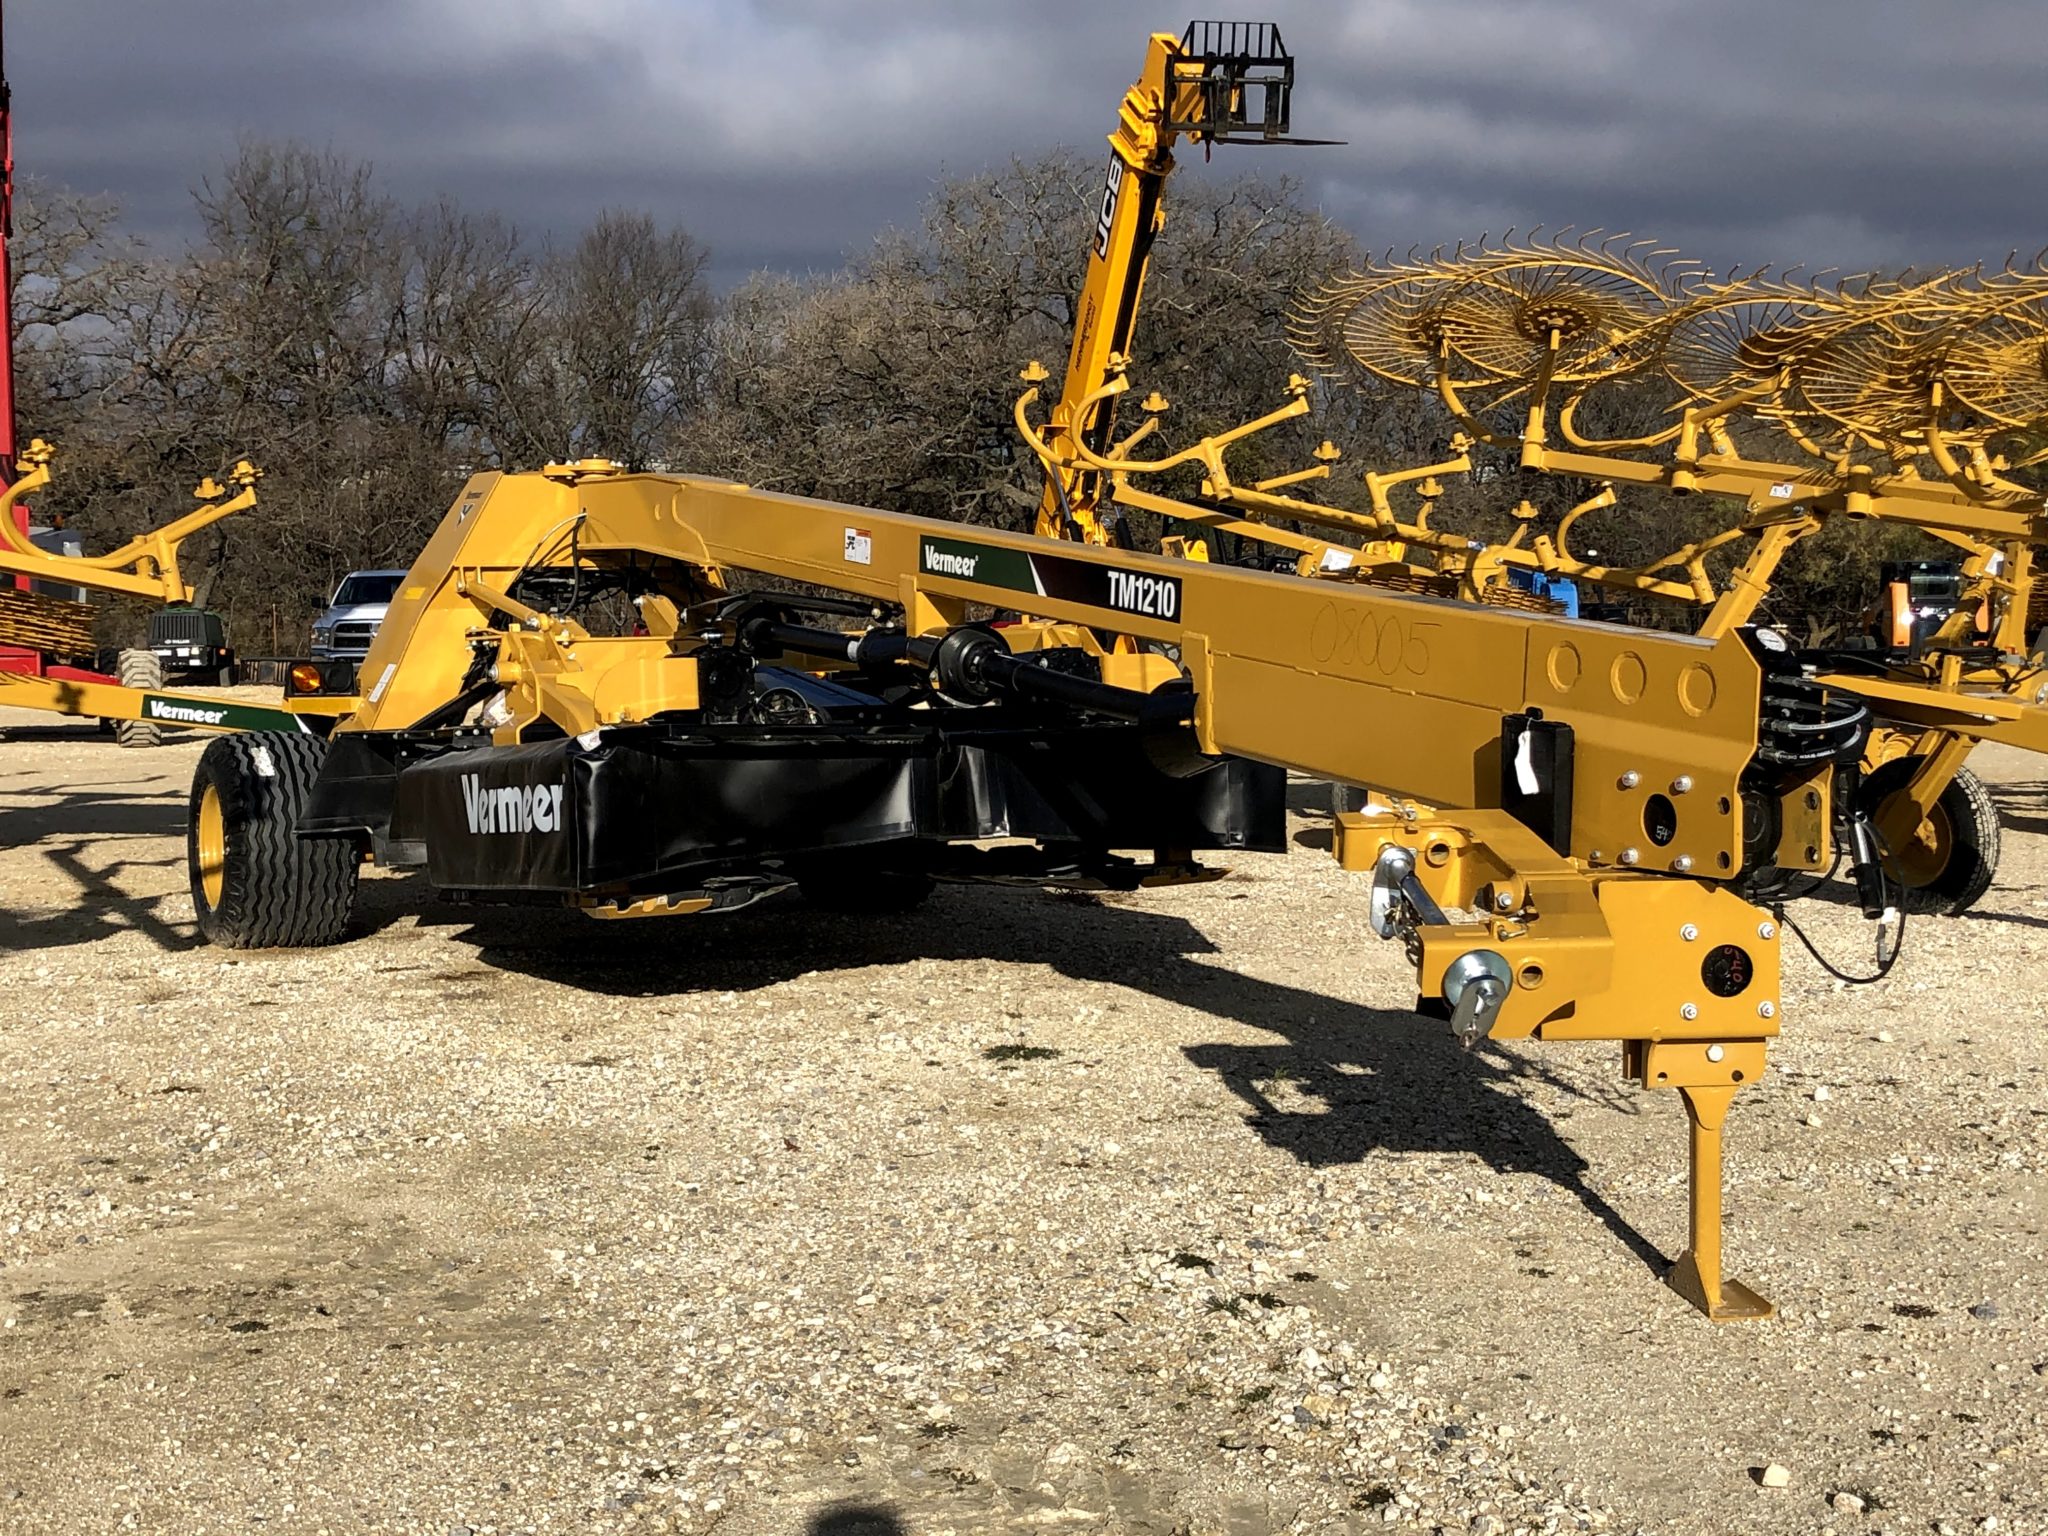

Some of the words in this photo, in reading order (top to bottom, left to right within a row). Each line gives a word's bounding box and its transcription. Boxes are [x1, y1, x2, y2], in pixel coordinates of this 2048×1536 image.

[1095, 155, 1124, 257] JCB
[925, 545, 976, 577] Vermeer
[1107, 570, 1176, 618] TM1210
[1310, 600, 1443, 676] 08005
[150, 700, 223, 724] Vermeer
[461, 773, 563, 835] Vermeer
